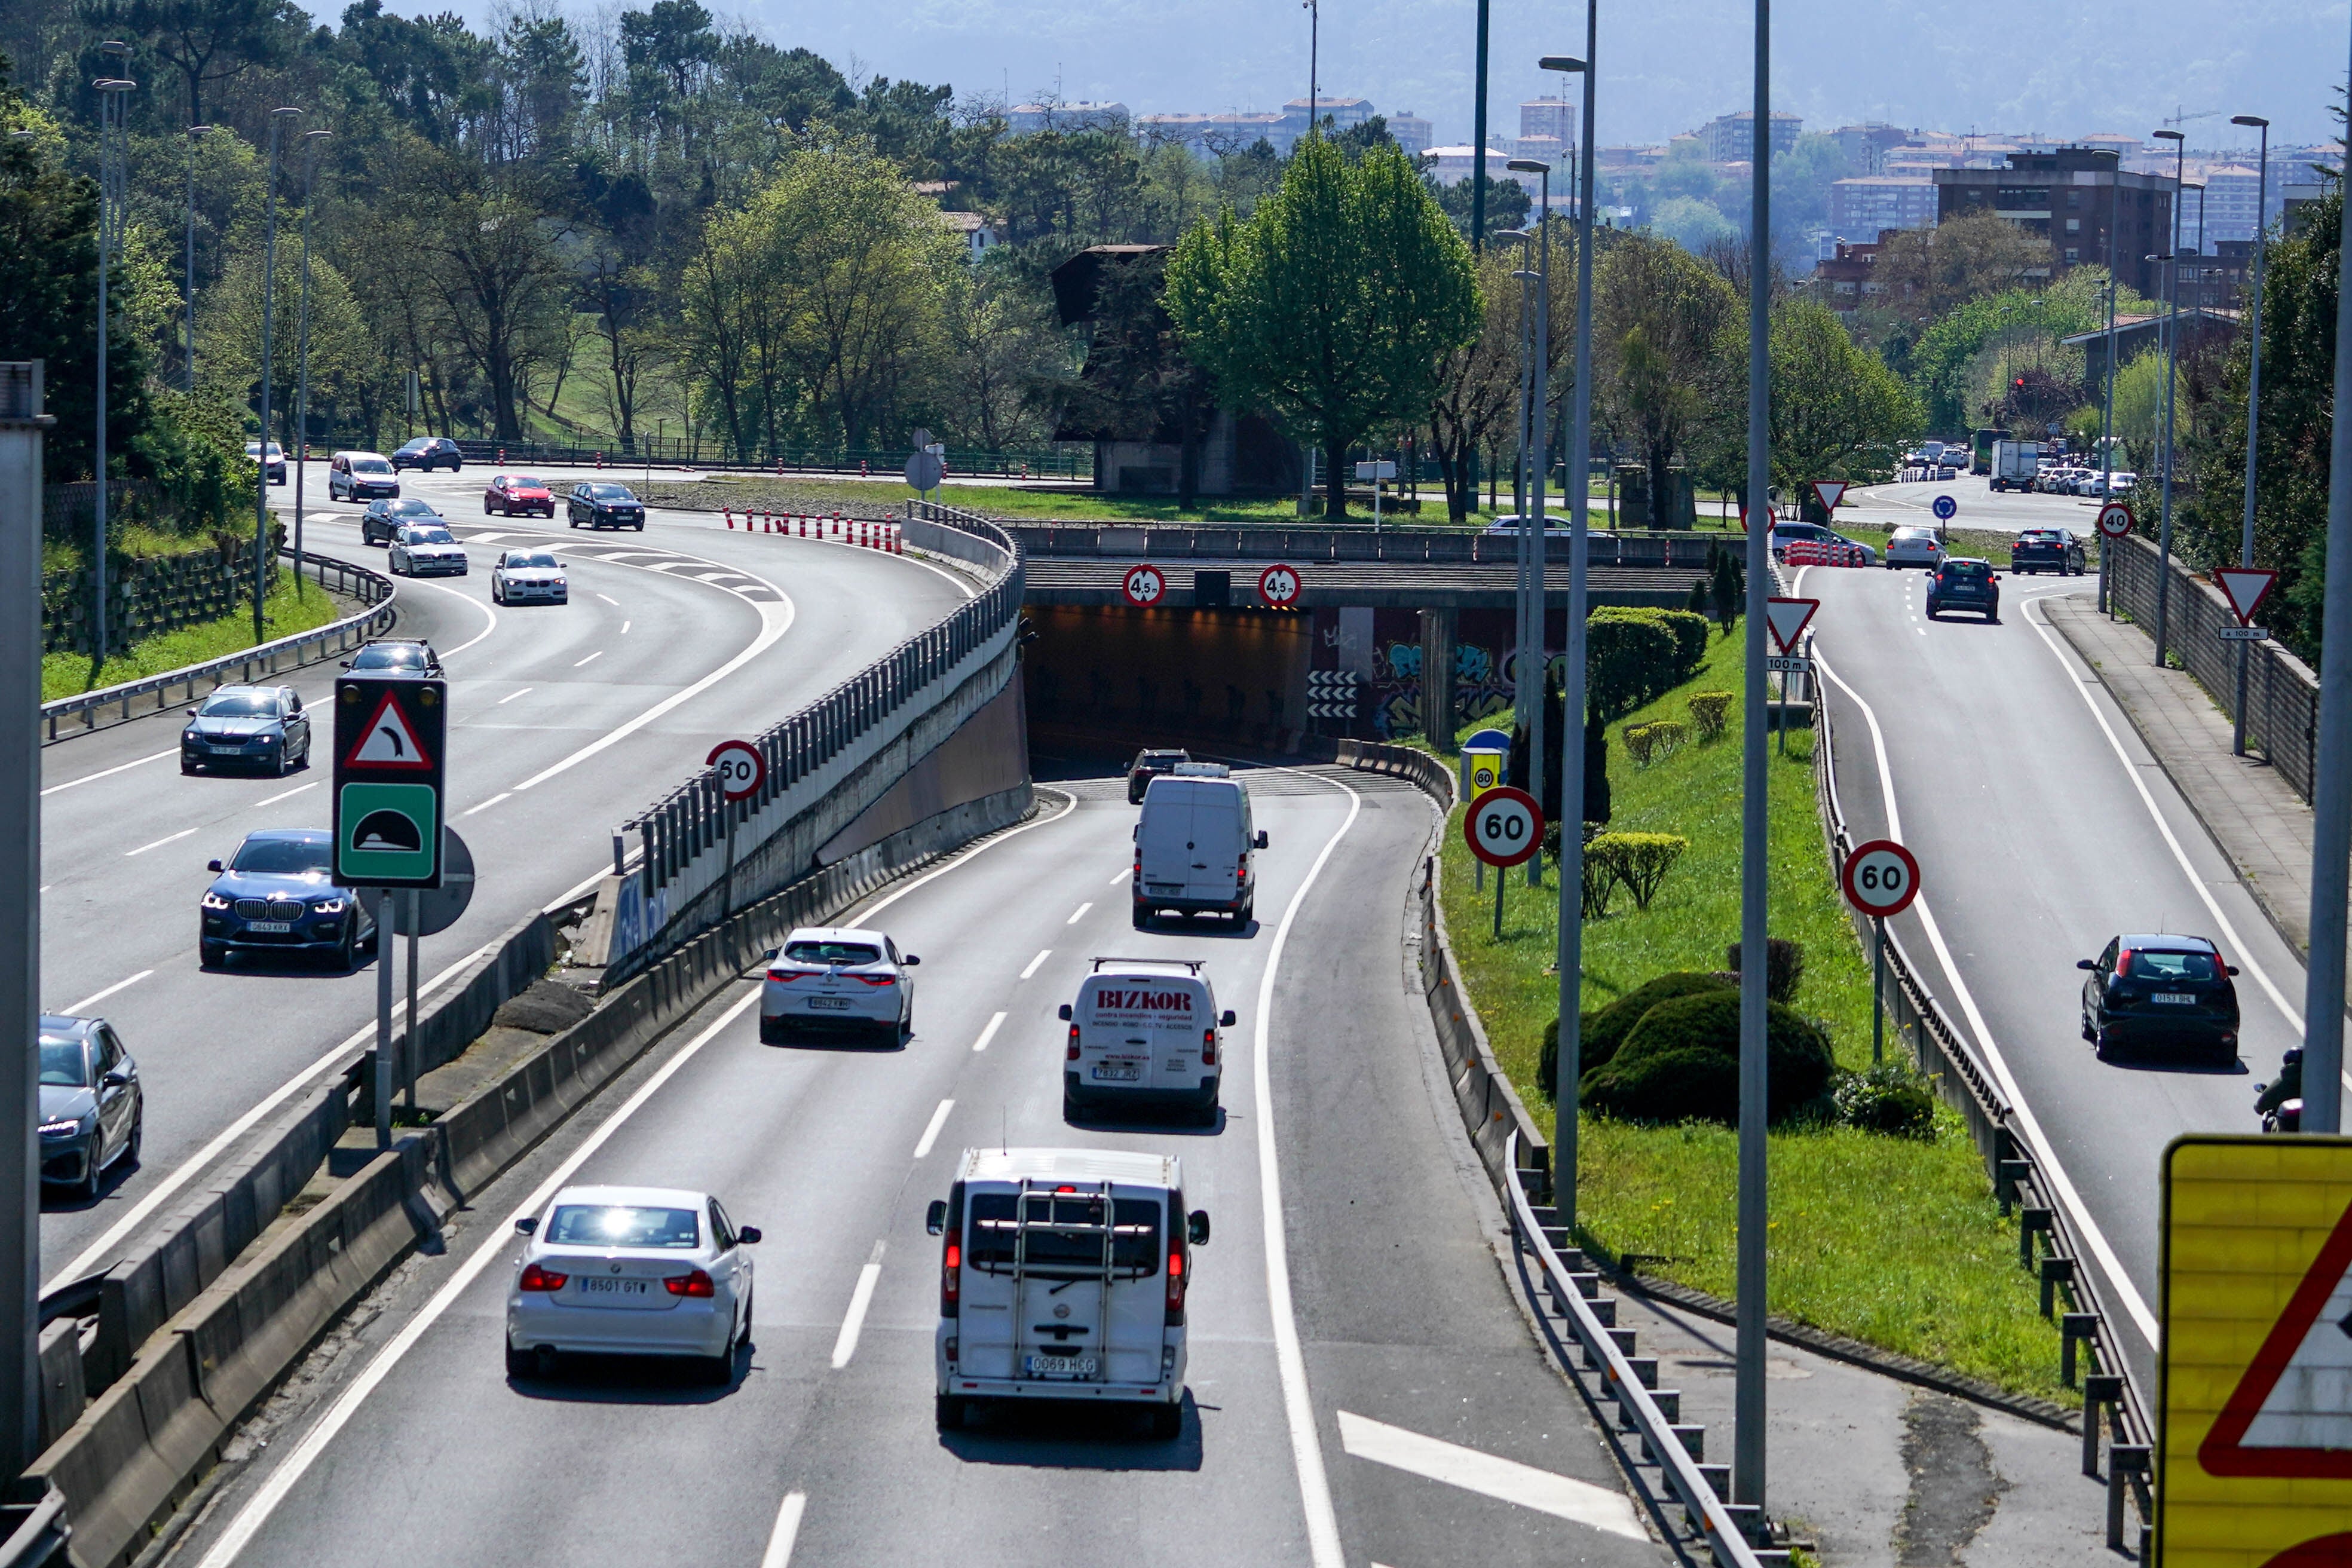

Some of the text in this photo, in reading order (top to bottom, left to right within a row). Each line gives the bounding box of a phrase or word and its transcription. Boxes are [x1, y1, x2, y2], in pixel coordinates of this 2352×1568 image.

[2106, 514, 2125, 526] 40
[1769, 659, 1790, 669] 100
[720, 760, 750, 780] 60
[1477, 773, 1490, 783] 60
[1485, 814, 1523, 840] 60
[1861, 865, 1900, 890] 60
[1097, 990, 1191, 1011] BIZKOR
[590, 1279, 618, 1292] 8501
[1034, 1358, 1065, 1370] 0069
